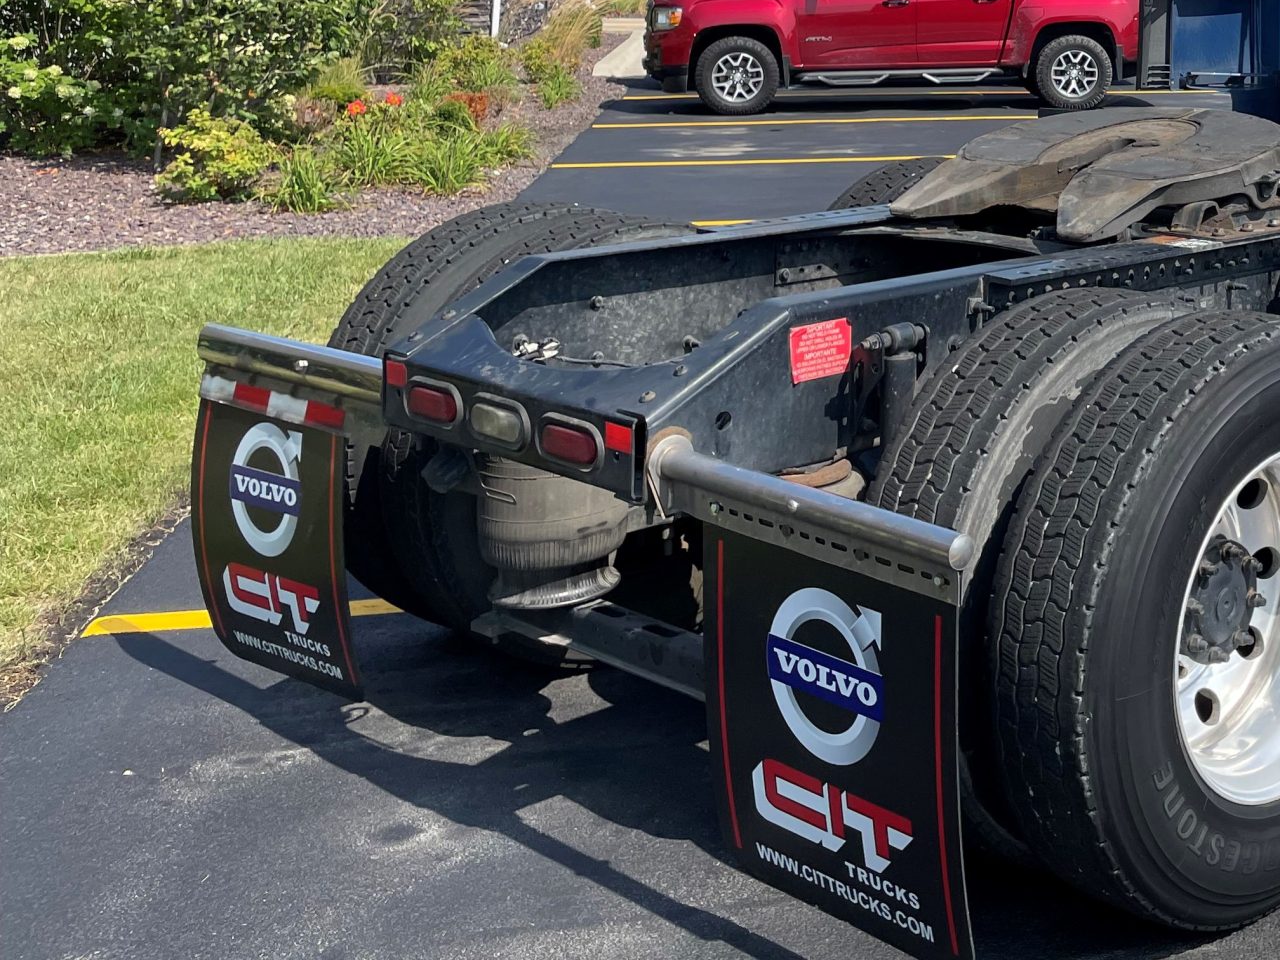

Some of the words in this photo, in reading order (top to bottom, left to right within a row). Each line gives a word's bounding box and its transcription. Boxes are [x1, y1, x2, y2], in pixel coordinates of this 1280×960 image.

[234, 473, 296, 506] VOLVO
[222, 561, 321, 635] CIT
[234, 630, 343, 680] WWW.CITTRUCKS.COM
[284, 630, 332, 657] TRUCKS
[773, 646, 878, 707] VOLVO
[751, 757, 914, 874] CIT
[756, 842, 934, 942] WWW.CITTRUCKS.COM
[844, 860, 921, 910] TRUCKS
